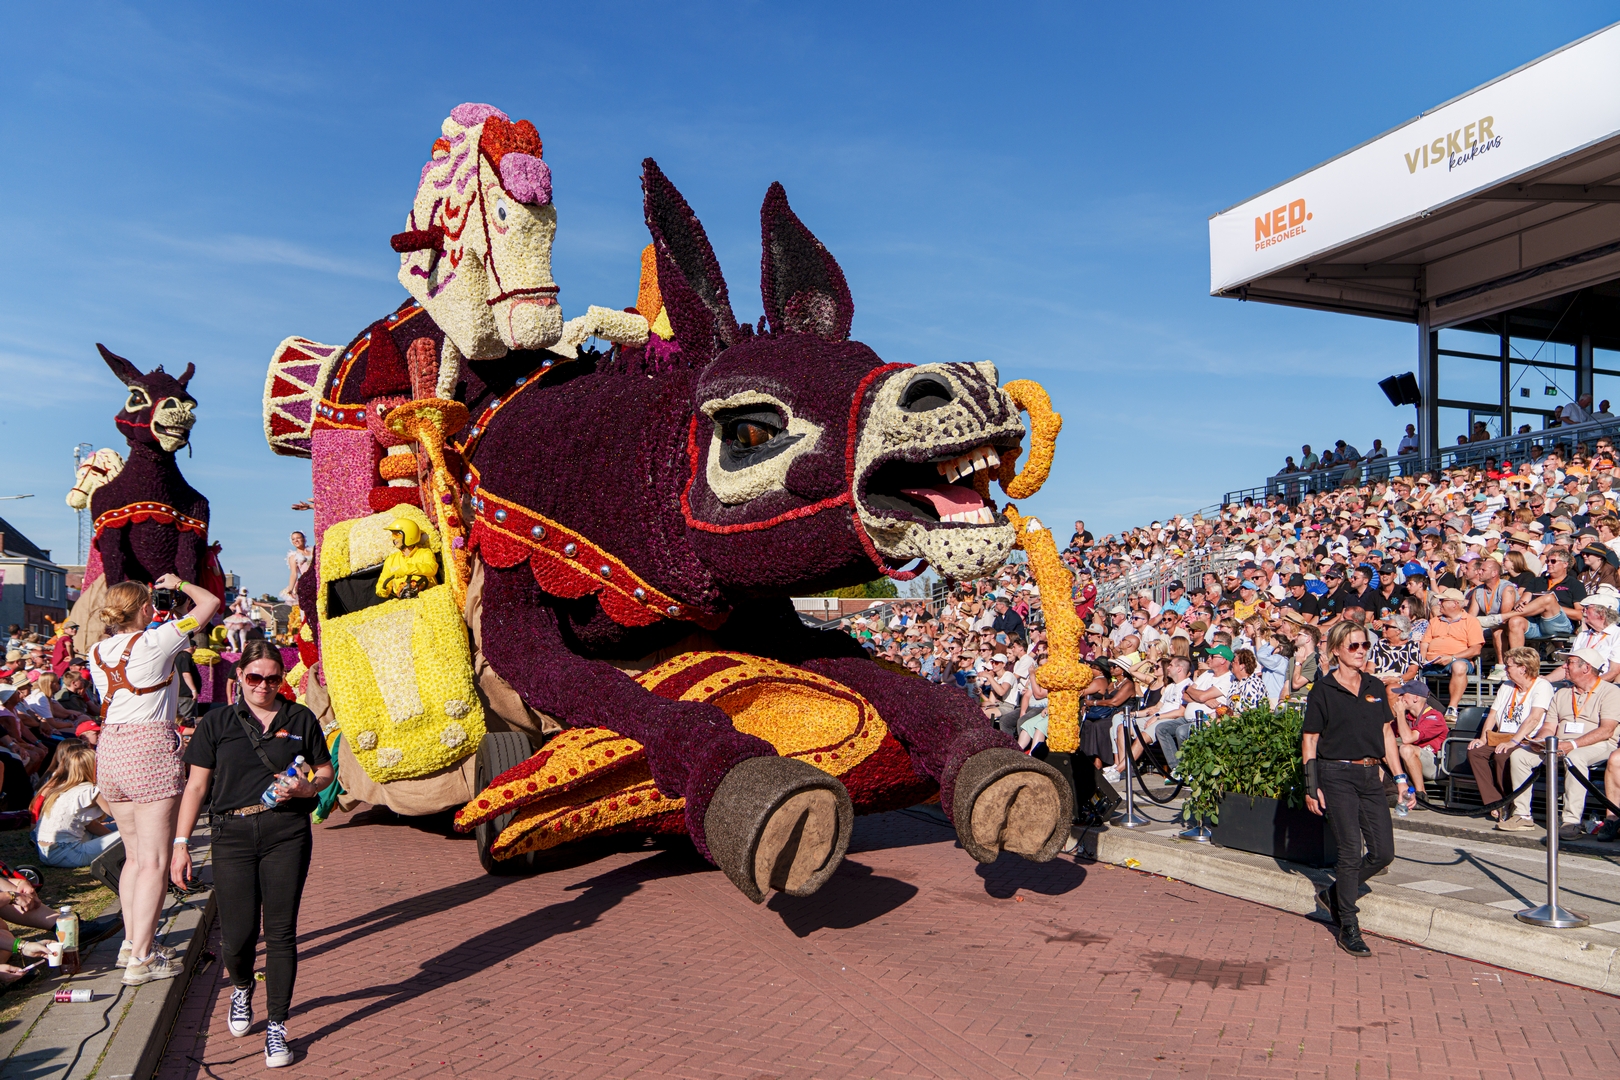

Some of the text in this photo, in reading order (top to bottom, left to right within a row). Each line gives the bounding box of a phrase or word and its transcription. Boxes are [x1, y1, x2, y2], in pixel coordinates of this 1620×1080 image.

[1404, 116, 1495, 174] VISKER
[1448, 135, 1503, 172] keukens
[1255, 198, 1312, 242] NED.
[1255, 225, 1306, 251] PERSONEEL
